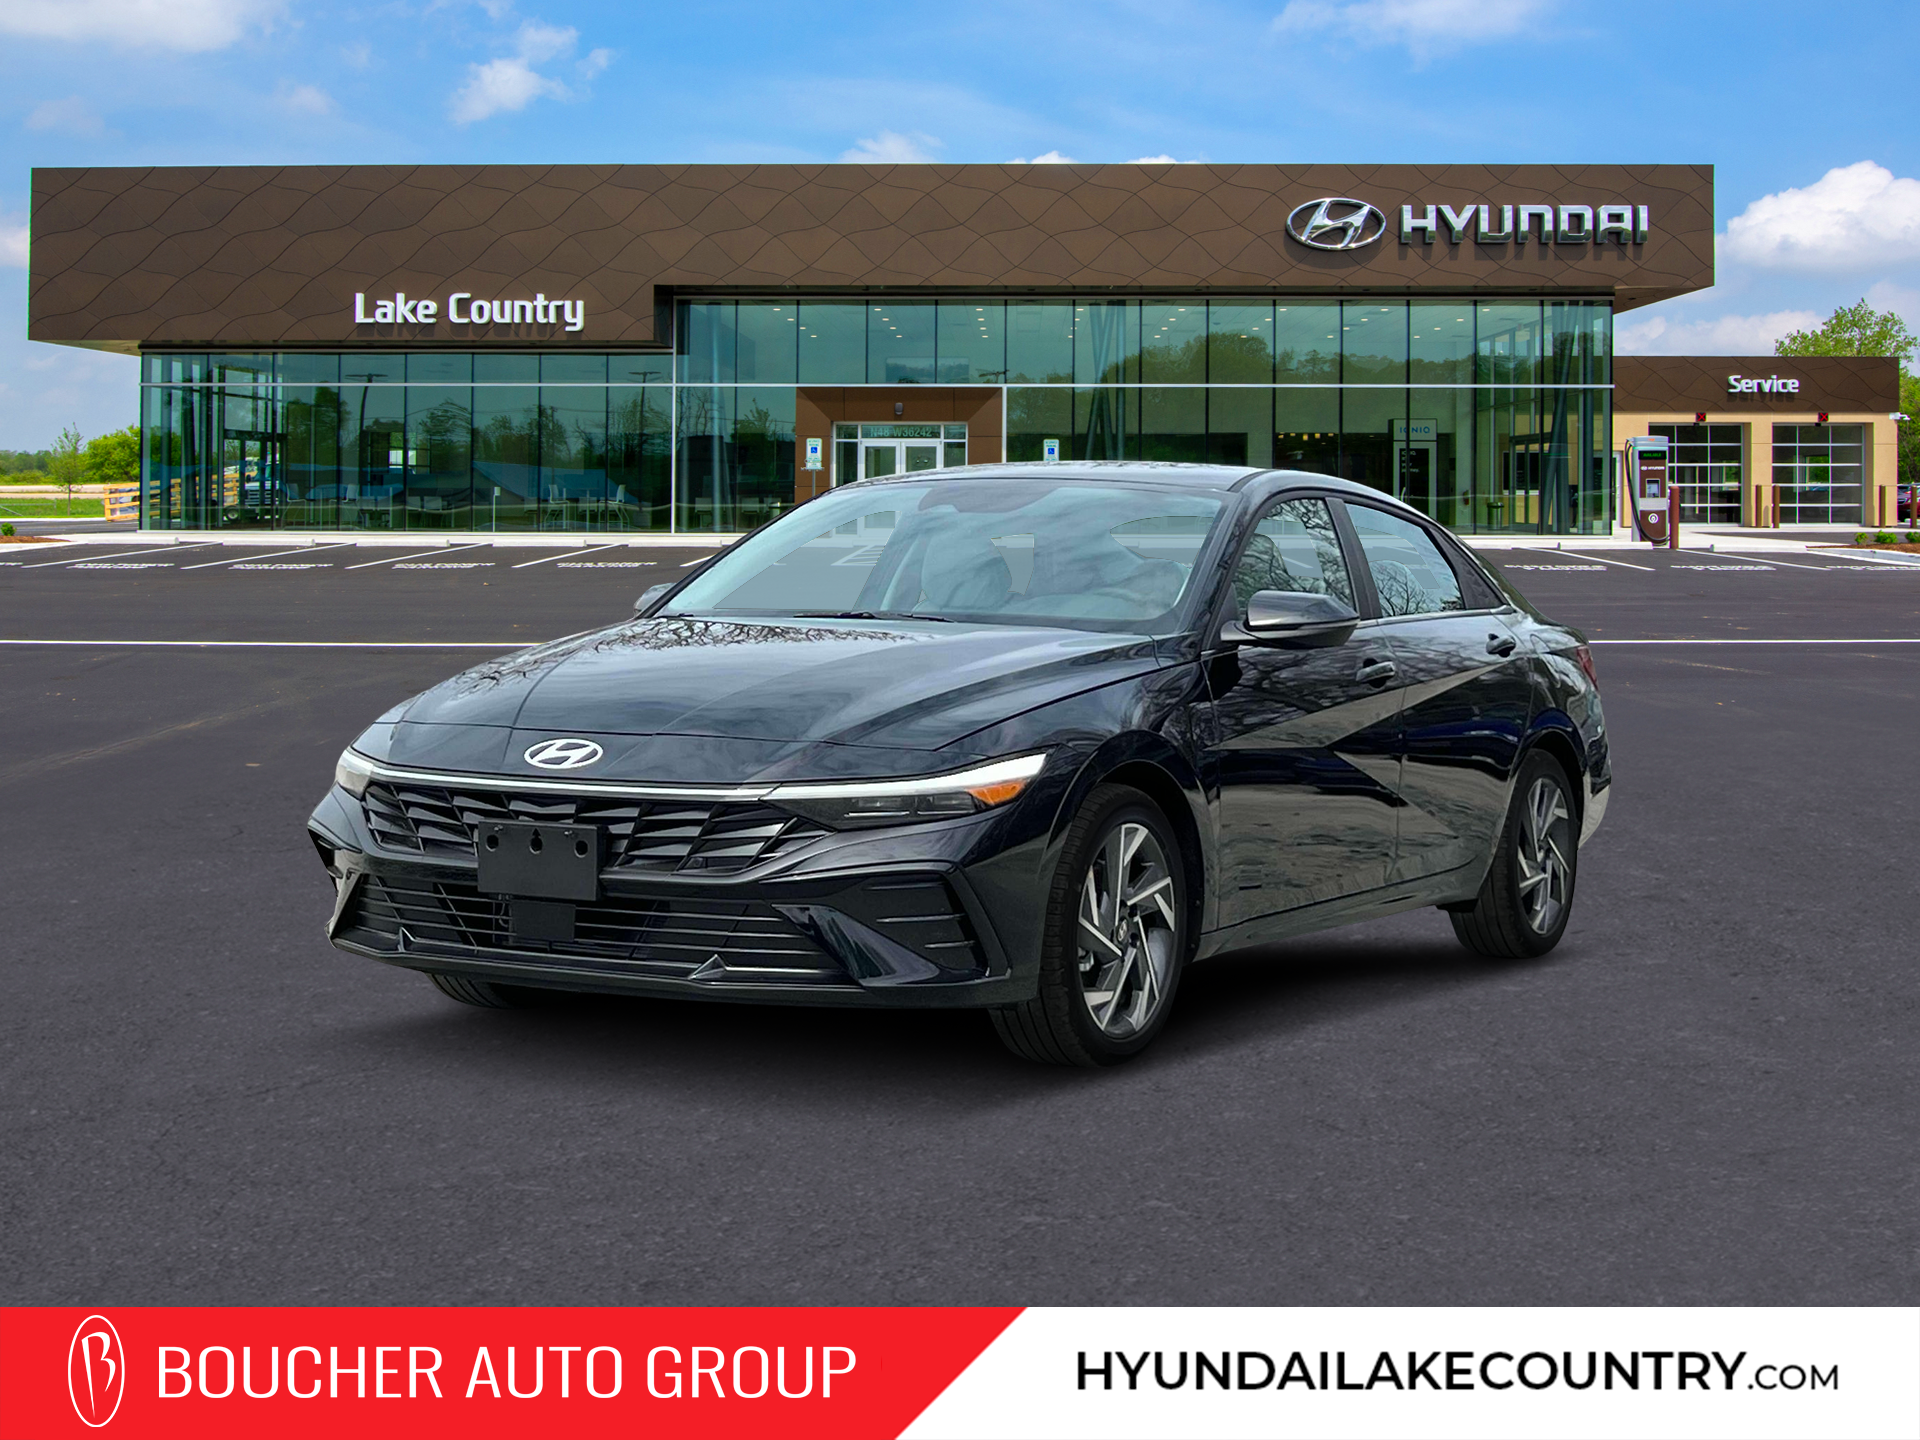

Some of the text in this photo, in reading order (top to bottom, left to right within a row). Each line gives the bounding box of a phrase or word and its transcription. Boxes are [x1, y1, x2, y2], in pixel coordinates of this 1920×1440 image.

[1400, 204, 1649, 244] HYUNDAI
[354, 292, 585, 332] Lake Country
[1727, 374, 1800, 393] Service
[870, 427, 932, 438] N48 W36242
